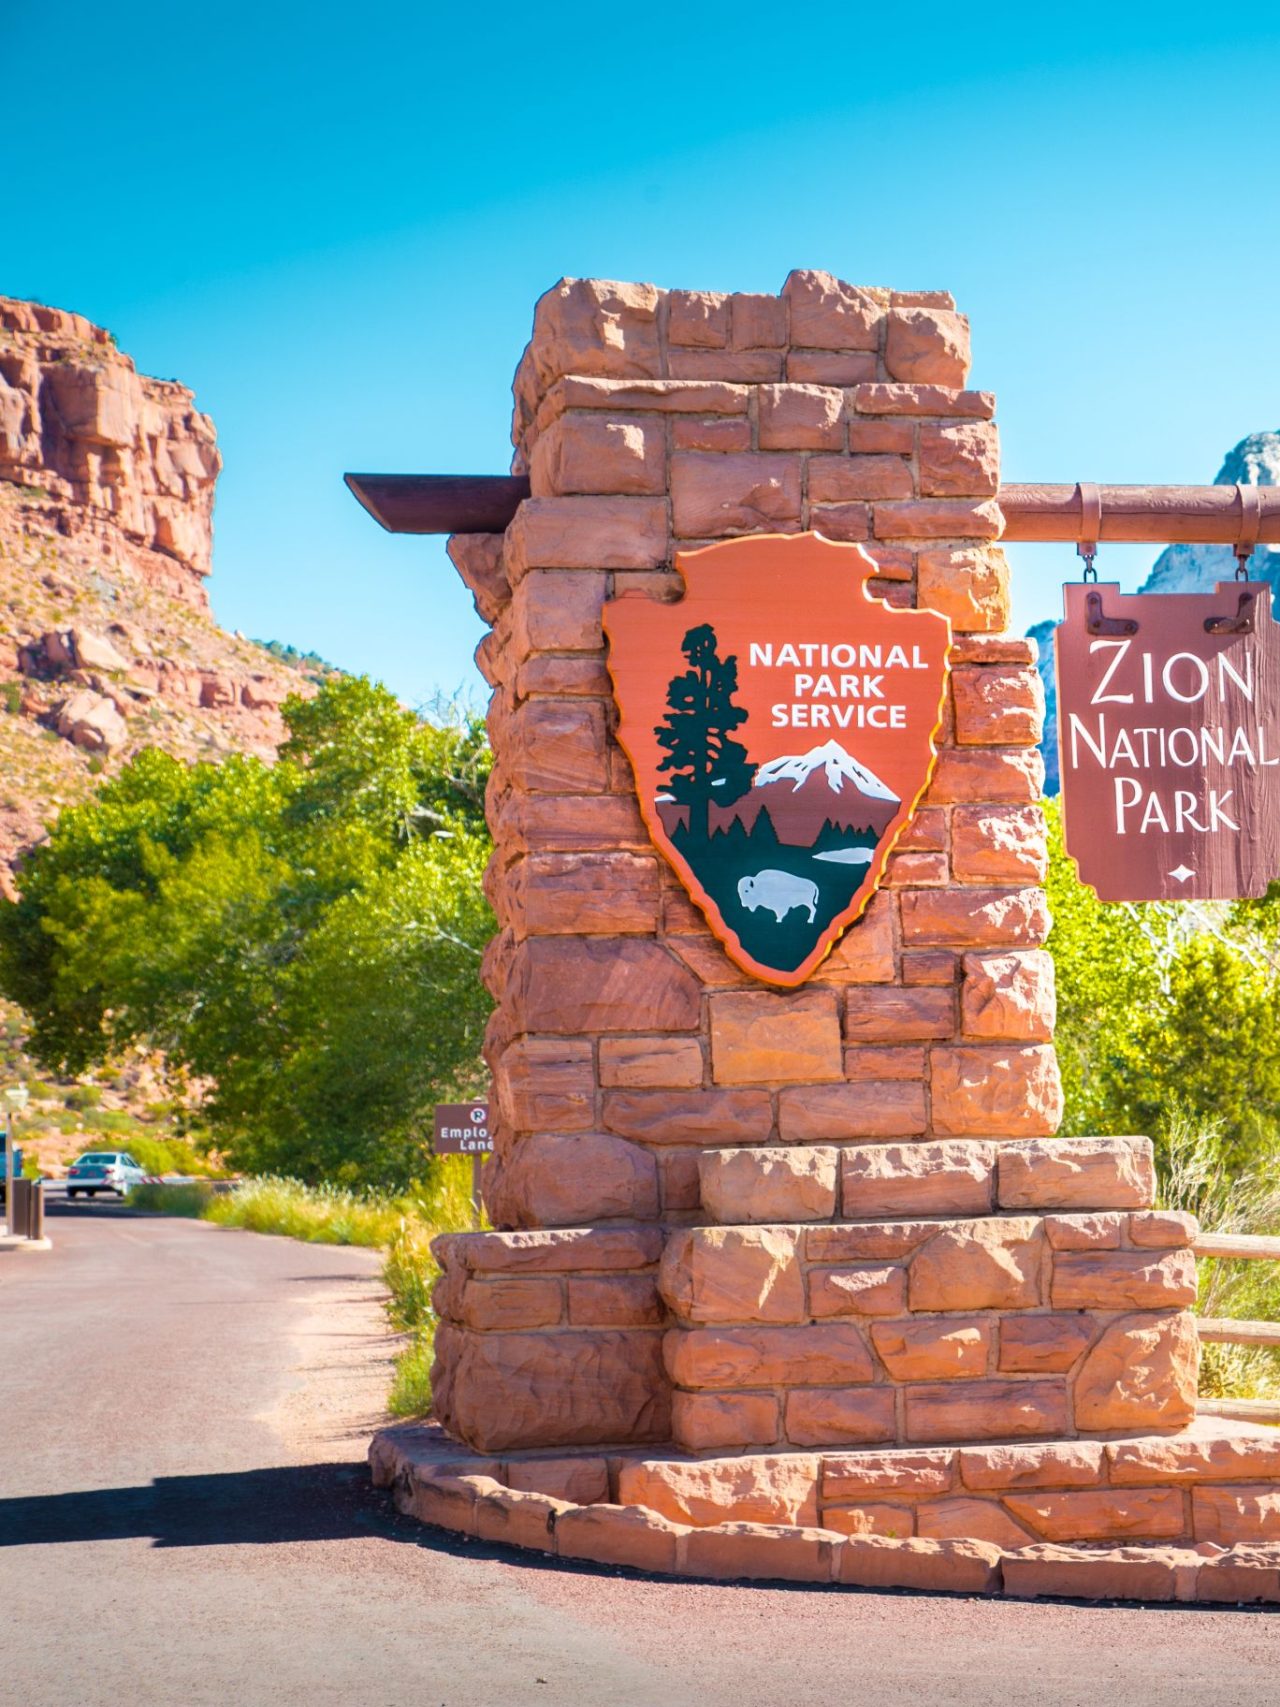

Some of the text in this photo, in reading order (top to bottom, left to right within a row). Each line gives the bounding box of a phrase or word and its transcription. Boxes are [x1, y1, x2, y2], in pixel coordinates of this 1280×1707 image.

[748, 643, 929, 669] NATIONAL
[1089, 639, 1254, 704] ZION
[794, 674, 885, 698] PARK
[771, 703, 907, 728] SERVICE
[1068, 713, 1280, 769] NATIONAL
[1114, 777, 1241, 834] PARK
[440, 1126, 493, 1140] Emplo
[459, 1140, 494, 1150] Lane
